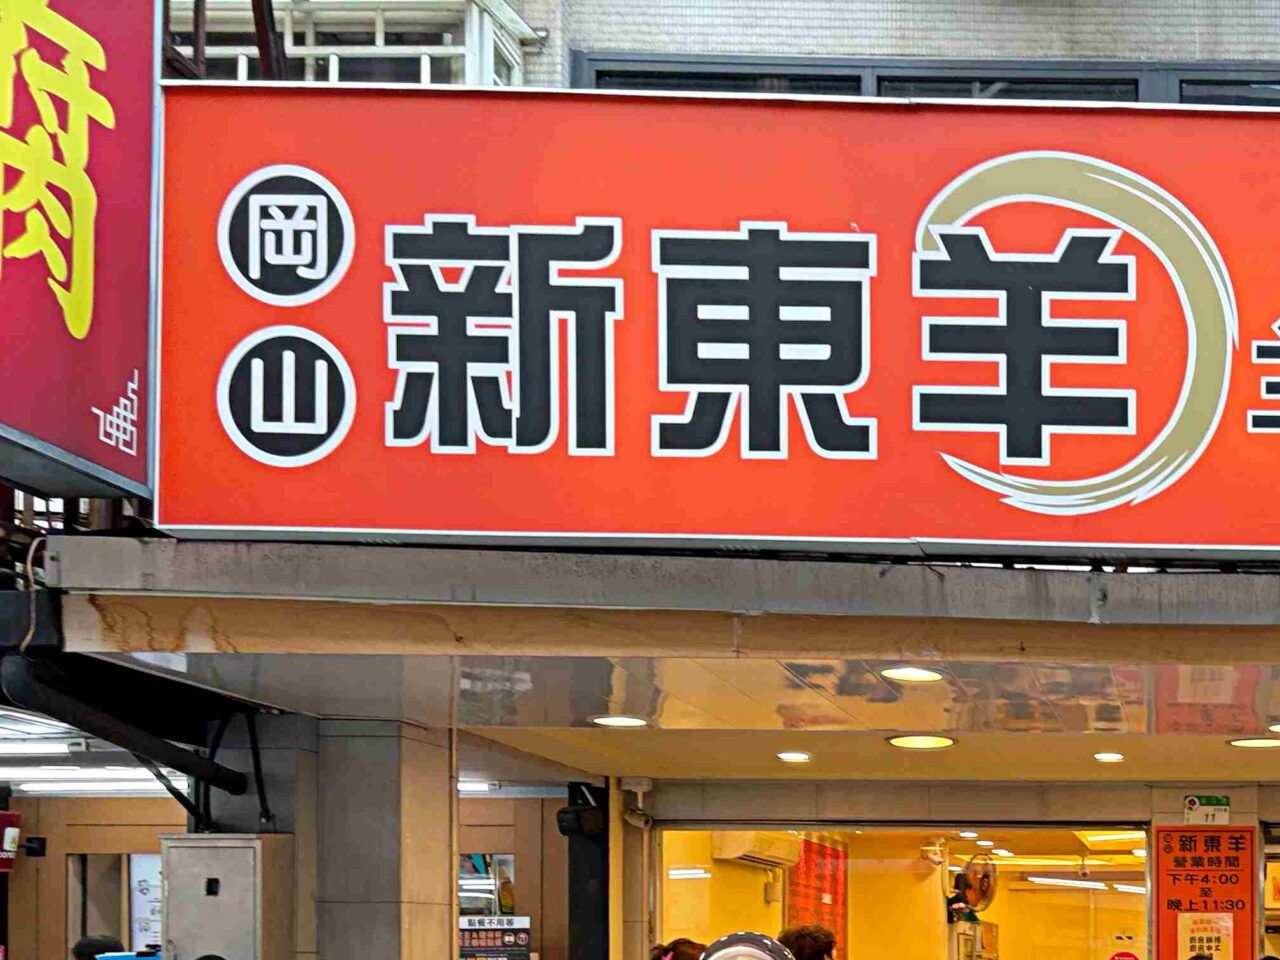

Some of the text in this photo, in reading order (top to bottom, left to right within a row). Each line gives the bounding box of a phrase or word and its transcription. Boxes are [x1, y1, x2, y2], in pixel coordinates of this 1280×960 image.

[249, 194, 329, 435] 岡山
[384, 213, 1136, 466] 新東羊
[1178, 834, 1247, 853] 新東羊
[1173, 855, 1240, 869] 營業時間
[1166, 873, 1239, 886] 下午4:00
[1199, 887, 1213, 898] 至
[1166, 899, 1246, 912] 晚上11:30
